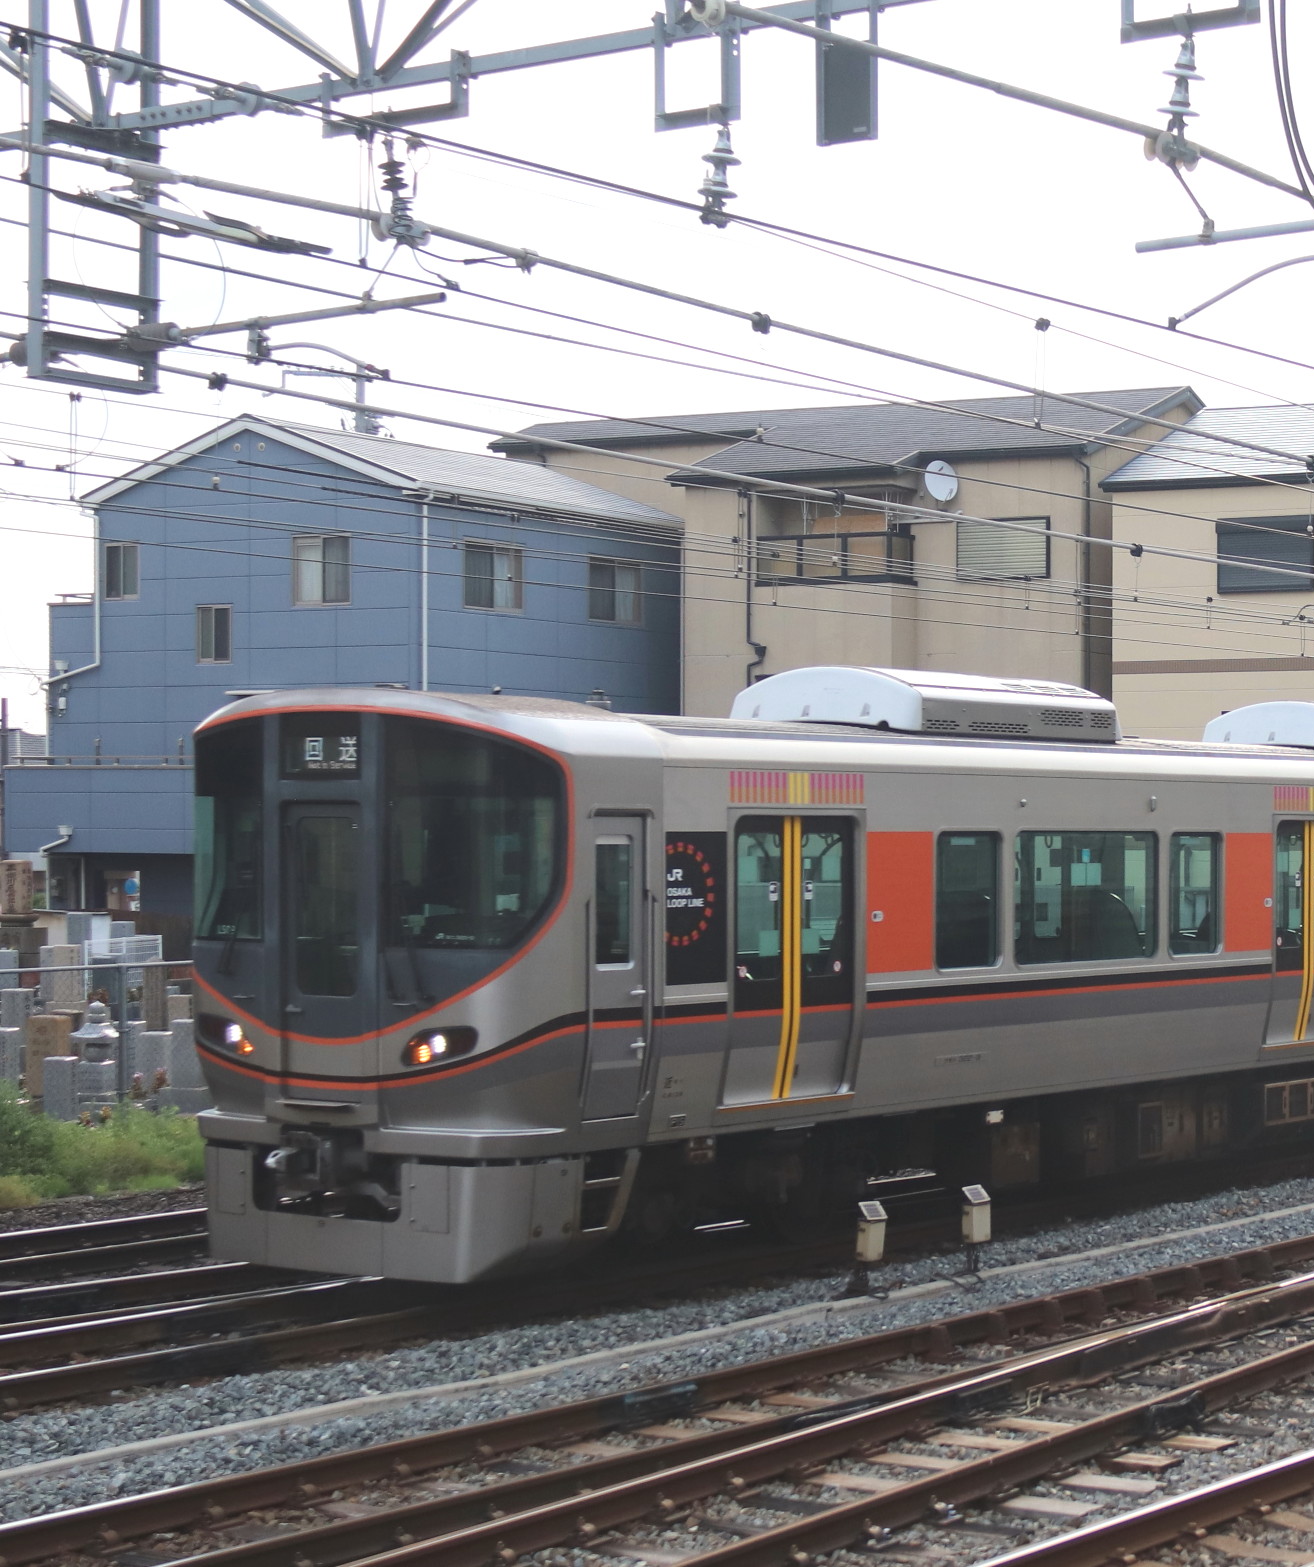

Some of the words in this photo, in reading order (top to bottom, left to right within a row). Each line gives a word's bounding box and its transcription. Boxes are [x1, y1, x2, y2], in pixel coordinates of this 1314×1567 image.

[305, 736, 357, 761] 回送
[667, 868, 683, 881] JR
[667, 887, 693, 896] OSAKA
[667, 898, 687, 908] LOOP
[687, 897, 705, 907] LINE
